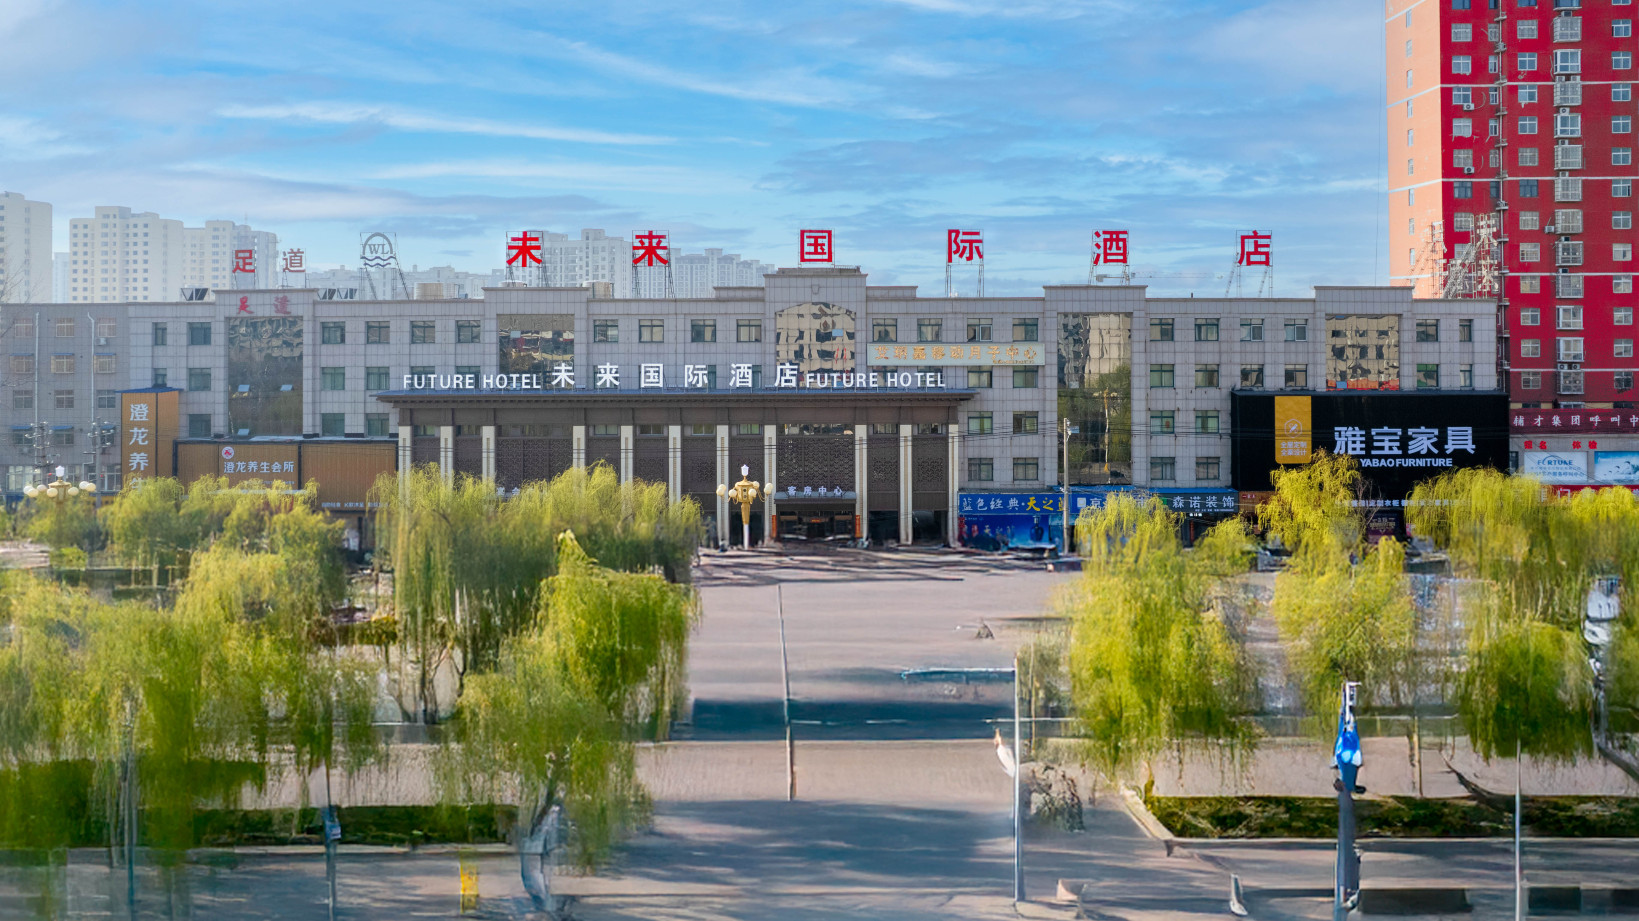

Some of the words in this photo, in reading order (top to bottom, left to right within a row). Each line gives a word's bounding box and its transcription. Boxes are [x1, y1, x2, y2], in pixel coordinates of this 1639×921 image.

[367, 243, 391, 255] WL
[506, 229, 1272, 267] 未来国际酒店
[232, 248, 306, 273] 足道
[403, 373, 475, 389] FUTURE
[482, 373, 542, 389] HOTEL
[551, 361, 799, 388] 未来国际酒店
[806, 372, 879, 388] FUTURE
[887, 372, 946, 388] HOTEL
[1333, 425, 1476, 455] 雅宝家具
[223, 461, 295, 474] 澄龙养生会所
[1360, 457, 1395, 468] YABAO
[1395, 457, 1453, 468] FURNITURE
[787, 485, 844, 497] 客房中心
[1172, 495, 1235, 510] 森诺装饰
